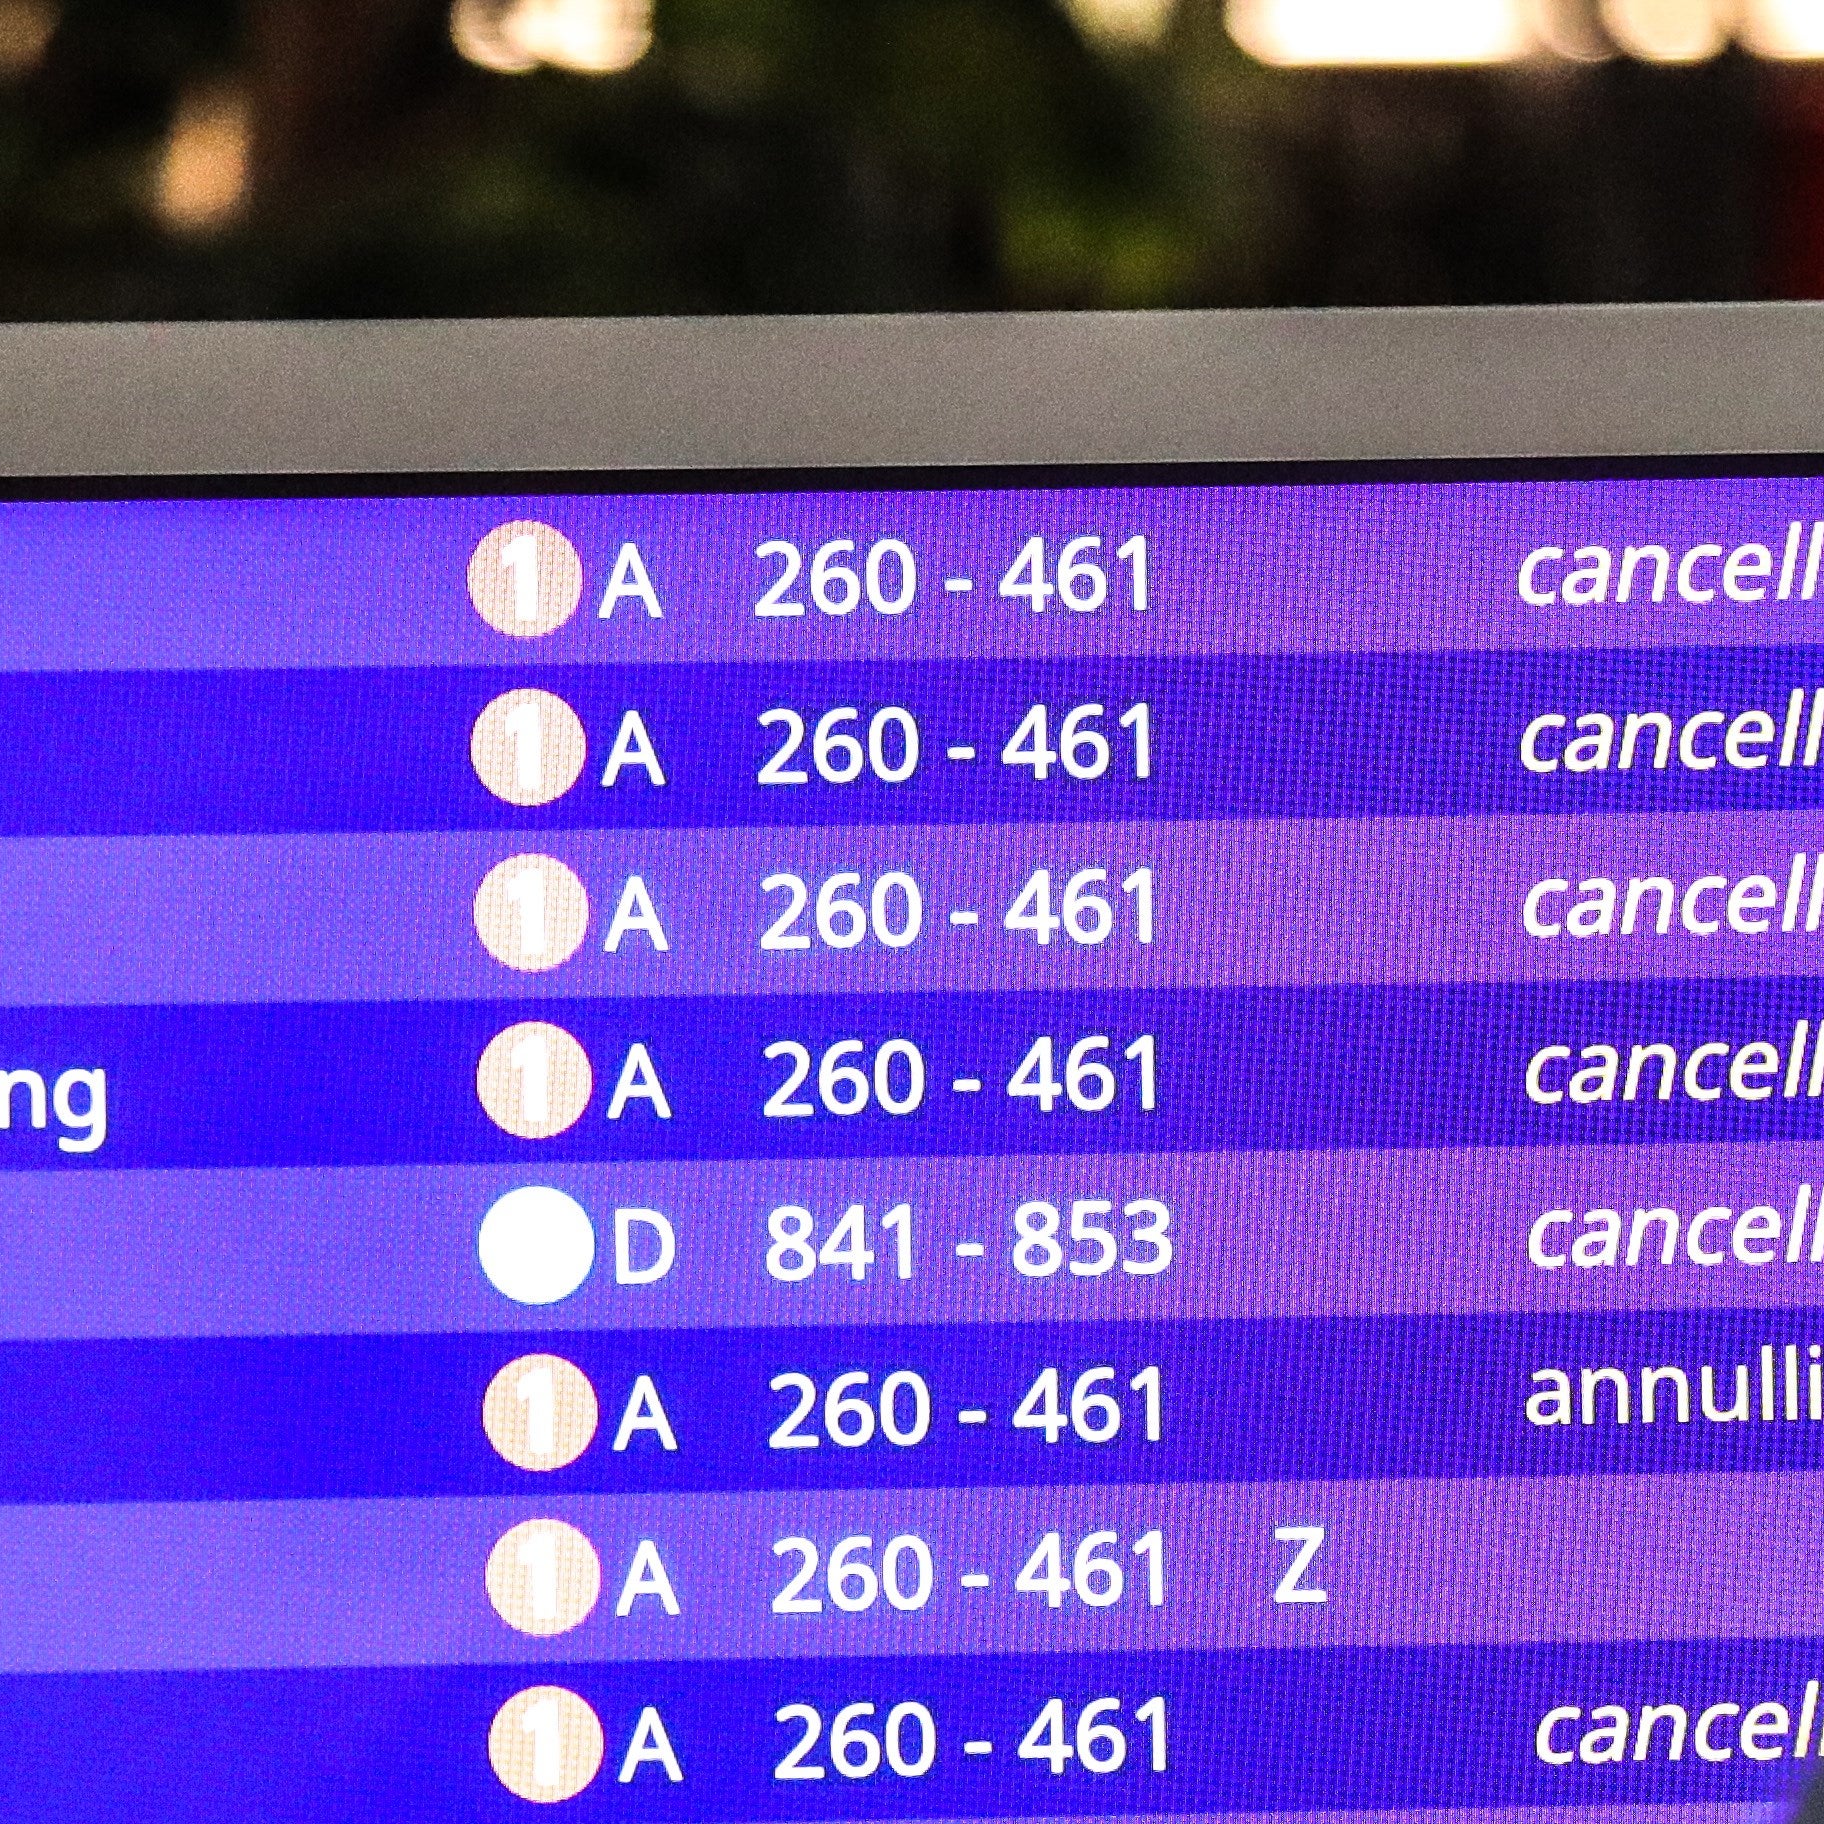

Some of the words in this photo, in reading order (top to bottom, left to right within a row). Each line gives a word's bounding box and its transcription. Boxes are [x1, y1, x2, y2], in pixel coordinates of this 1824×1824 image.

[499, 531, 543, 625] 1
[597, 541, 666, 620] A
[753, 537, 918, 618] 260
[998, 533, 1149, 615] 461
[502, 699, 546, 793] 1
[600, 709, 667, 788] A
[756, 705, 920, 786] 260
[1001, 701, 1151, 781] 461
[504, 863, 548, 960] 1
[602, 873, 670, 955] A
[759, 868, 924, 952] 260
[1002, 864, 1154, 946] 461
[508, 1032, 552, 1125] 1
[606, 1042, 673, 1120] A
[762, 1037, 925, 1119] 260
[1006, 1033, 1156, 1113] 461
[613, 1207, 677, 1286] D
[764, 1201, 913, 1283] 841
[1011, 1195, 1174, 1280] 853
[514, 1364, 558, 1457] 1
[612, 1374, 679, 1452] A
[767, 1369, 931, 1450] 260
[1011, 1364, 1161, 1444] 461
[517, 1528, 561, 1623] 1
[615, 1538, 682, 1618] A
[770, 1532, 935, 1615] 260
[1013, 1527, 1165, 1609] 461
[1272, 1519, 1330, 1605] Z
[519, 1695, 563, 1789] 1
[617, 1705, 684, 1784] A
[773, 1700, 937, 1781] 260
[1016, 1695, 1167, 1775] 461
